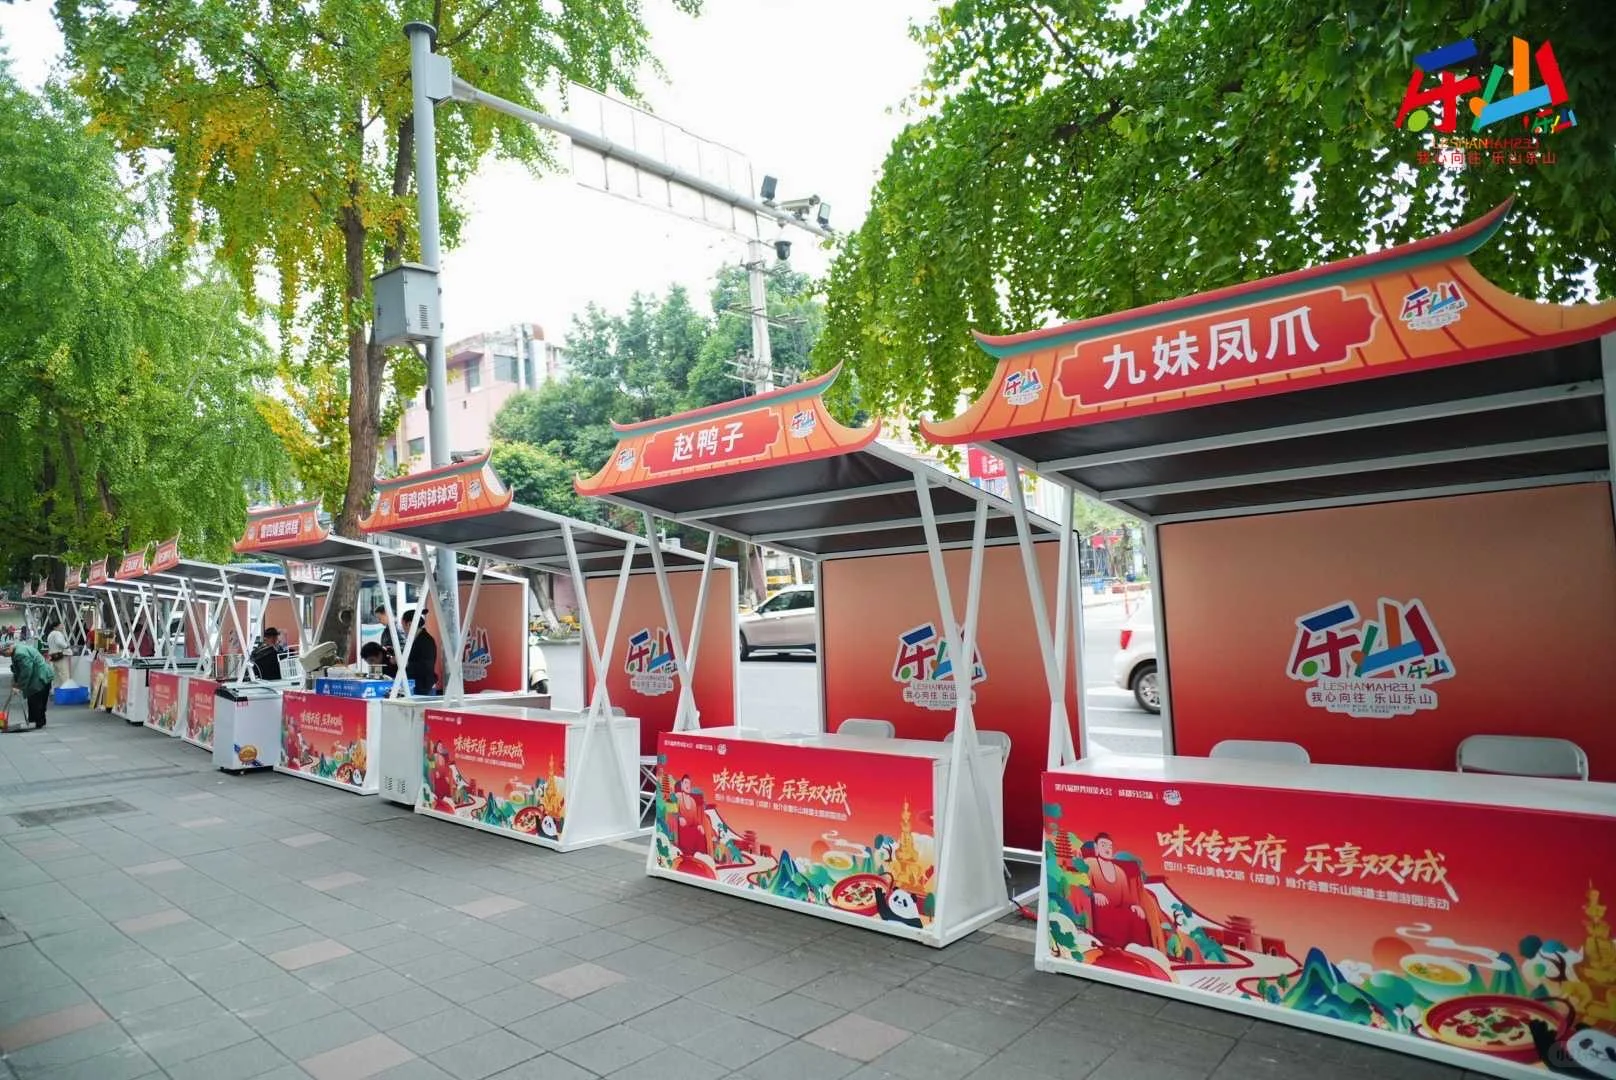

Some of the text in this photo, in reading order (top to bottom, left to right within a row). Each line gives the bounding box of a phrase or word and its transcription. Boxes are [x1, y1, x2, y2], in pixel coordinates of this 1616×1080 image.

[1102, 305, 1320, 390] 九妹凤爪
[671, 421, 744, 463] 赵鸭子
[399, 483, 459, 512] 周鸡肉钵钵鸡
[1311, 692, 1432, 705] 我心向往 乐山乐山
[712, 767, 775, 800] 味传天府
[778, 777, 851, 816] 乐享双城
[1156, 823, 1460, 903] 味传天府 乐享双城
